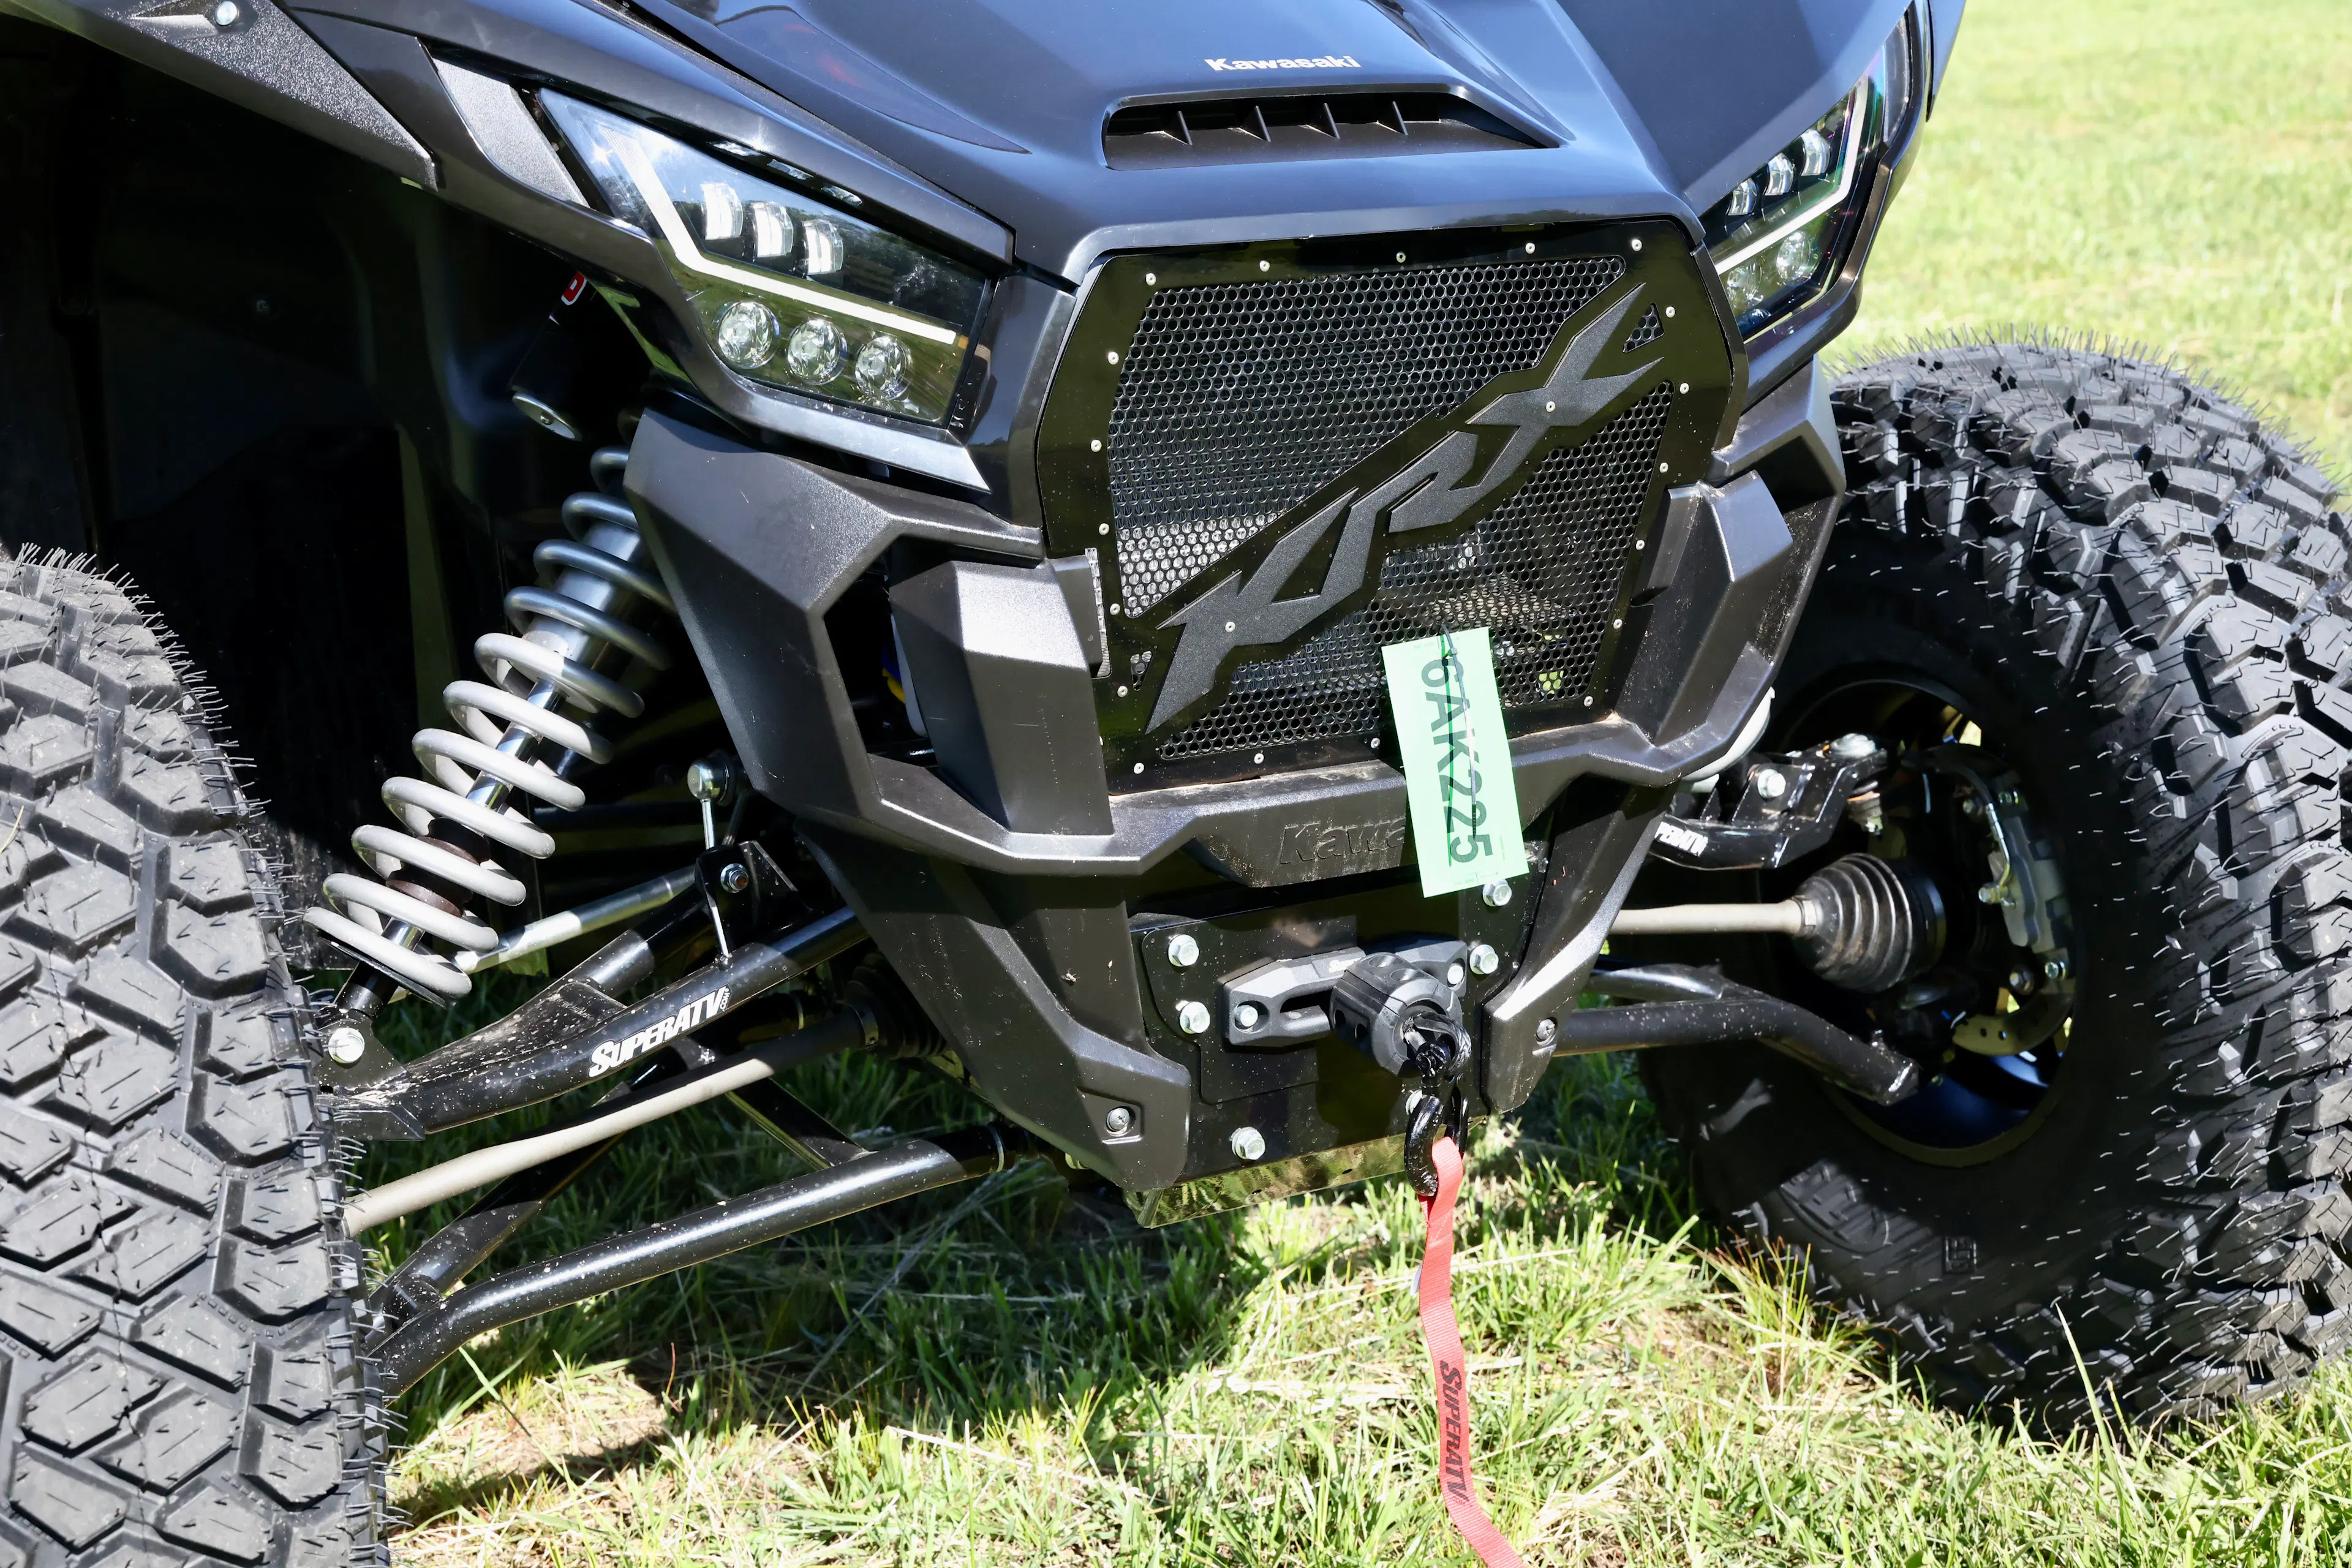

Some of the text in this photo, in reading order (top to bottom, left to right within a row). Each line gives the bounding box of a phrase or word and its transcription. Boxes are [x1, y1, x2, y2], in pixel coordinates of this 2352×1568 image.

[1204, 55, 1362, 71] Kawasaki
[1421, 657, 1493, 864] 6AK225
[1280, 814, 1406, 865] Kawa
[1654, 821, 1705, 854] PERATV
